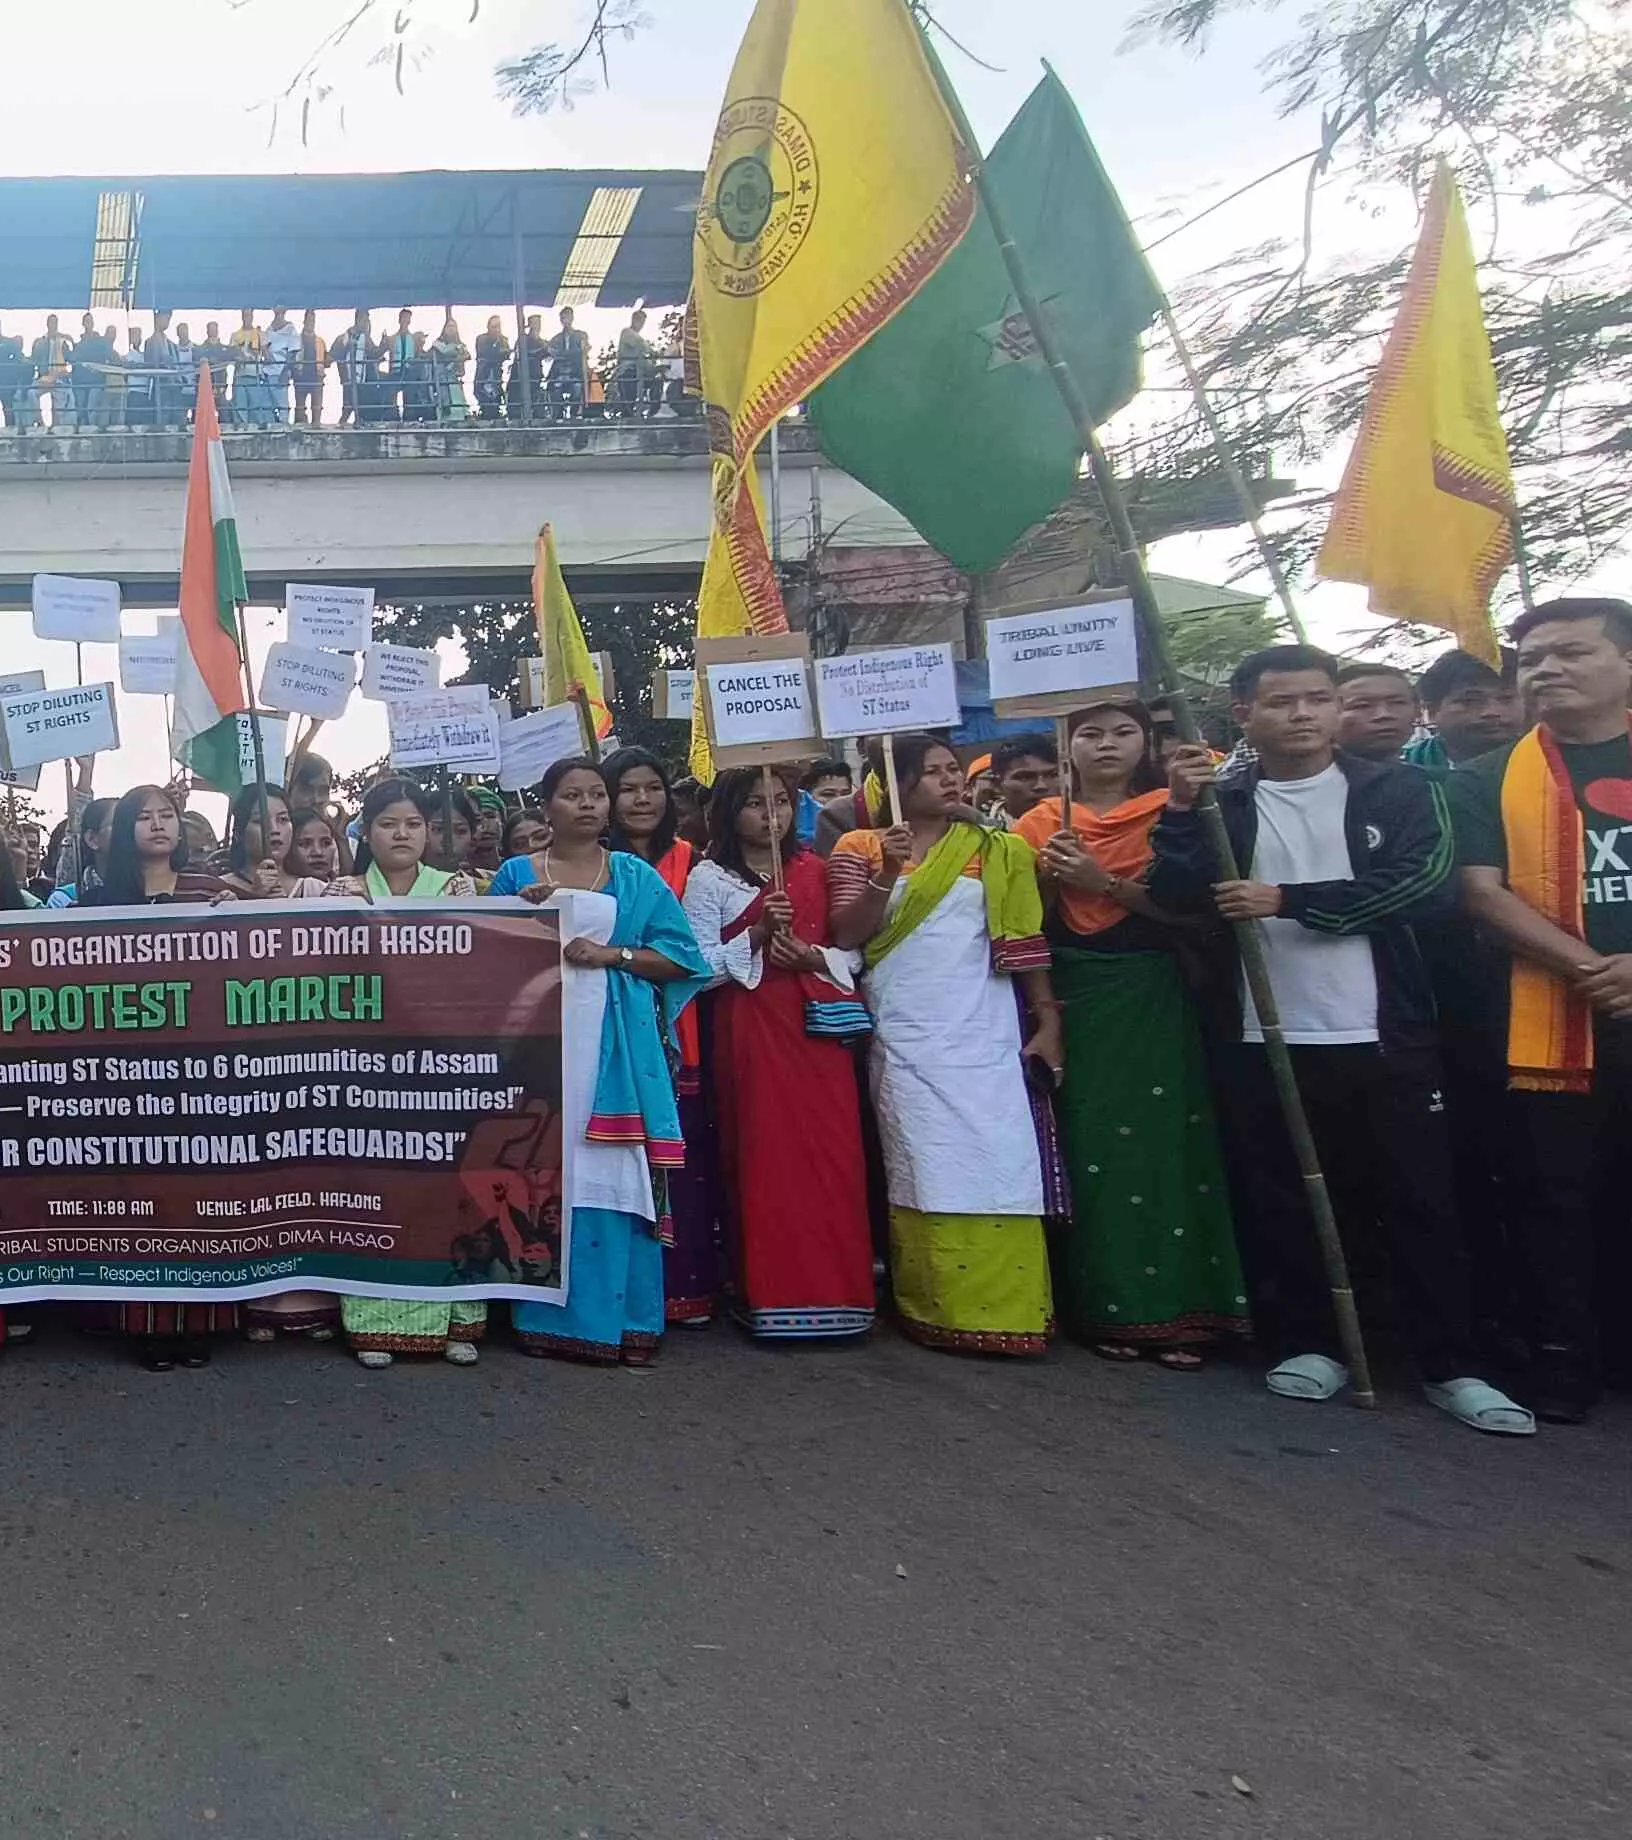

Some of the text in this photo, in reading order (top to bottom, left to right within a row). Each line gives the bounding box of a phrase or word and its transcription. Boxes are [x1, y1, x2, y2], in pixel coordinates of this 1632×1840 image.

[999, 617, 1118, 643] TRIBAL UNITY
[1013, 639, 1105, 662] LONG LIVE
[275, 658, 345, 682] STOP DILUTING
[822, 650, 944, 680] Protect Indigenous Right
[281, 678, 329, 697] ST RIGHTS
[718, 672, 801, 693] CANCEL THE
[6, 702, 40, 718] STOP
[43, 689, 103, 711] DILUTING
[726, 697, 802, 716] PROPOSAL
[862, 697, 911, 716] ST Status
[26, 711, 91, 734] ST RIGHTS
[31, 930, 238, 967] ORGANISATION
[249, 927, 282, 959] OF
[291, 925, 370, 956] DIMA
[379, 925, 473, 955] HASAO
[0, 980, 192, 1034] PROTEST
[224, 974, 384, 1026] MARCH
[73, 1058, 99, 1081] ST
[105, 1056, 179, 1081] Status
[183, 1056, 207, 1080] to
[213, 1055, 228, 1079] 6
[234, 1048, 386, 1078] Communities
[392, 1049, 416, 1074] of
[420, 1050, 498, 1074] Assam
[26, 1094, 131, 1117] Preserve
[136, 1094, 175, 1115] the
[181, 1088, 280, 1117] Integrity
[286, 1086, 309, 1110] of
[312, 1085, 341, 1107] ST
[347, 1085, 524, 1111] Communities!”
[27, 1135, 260, 1166] CONSTITUTIONAL
[265, 1127, 466, 1161] SAFEGUARDS!”
[48, 1200, 154, 1216] TIME: 11:00 AM
[196, 1191, 381, 1216] VENUE: LAL HAFLONG
[47, 1237, 130, 1252] STUDENTS
[135, 1235, 273, 1254] ORGANISATION,
[279, 1229, 325, 1245] DIMA
[329, 1230, 395, 1250] HASAO
[7, 1267, 34, 1282] Our
[38, 1265, 74, 1283] Right
[99, 1265, 160, 1283] Respect
[164, 1267, 248, 1285] Indigenous
